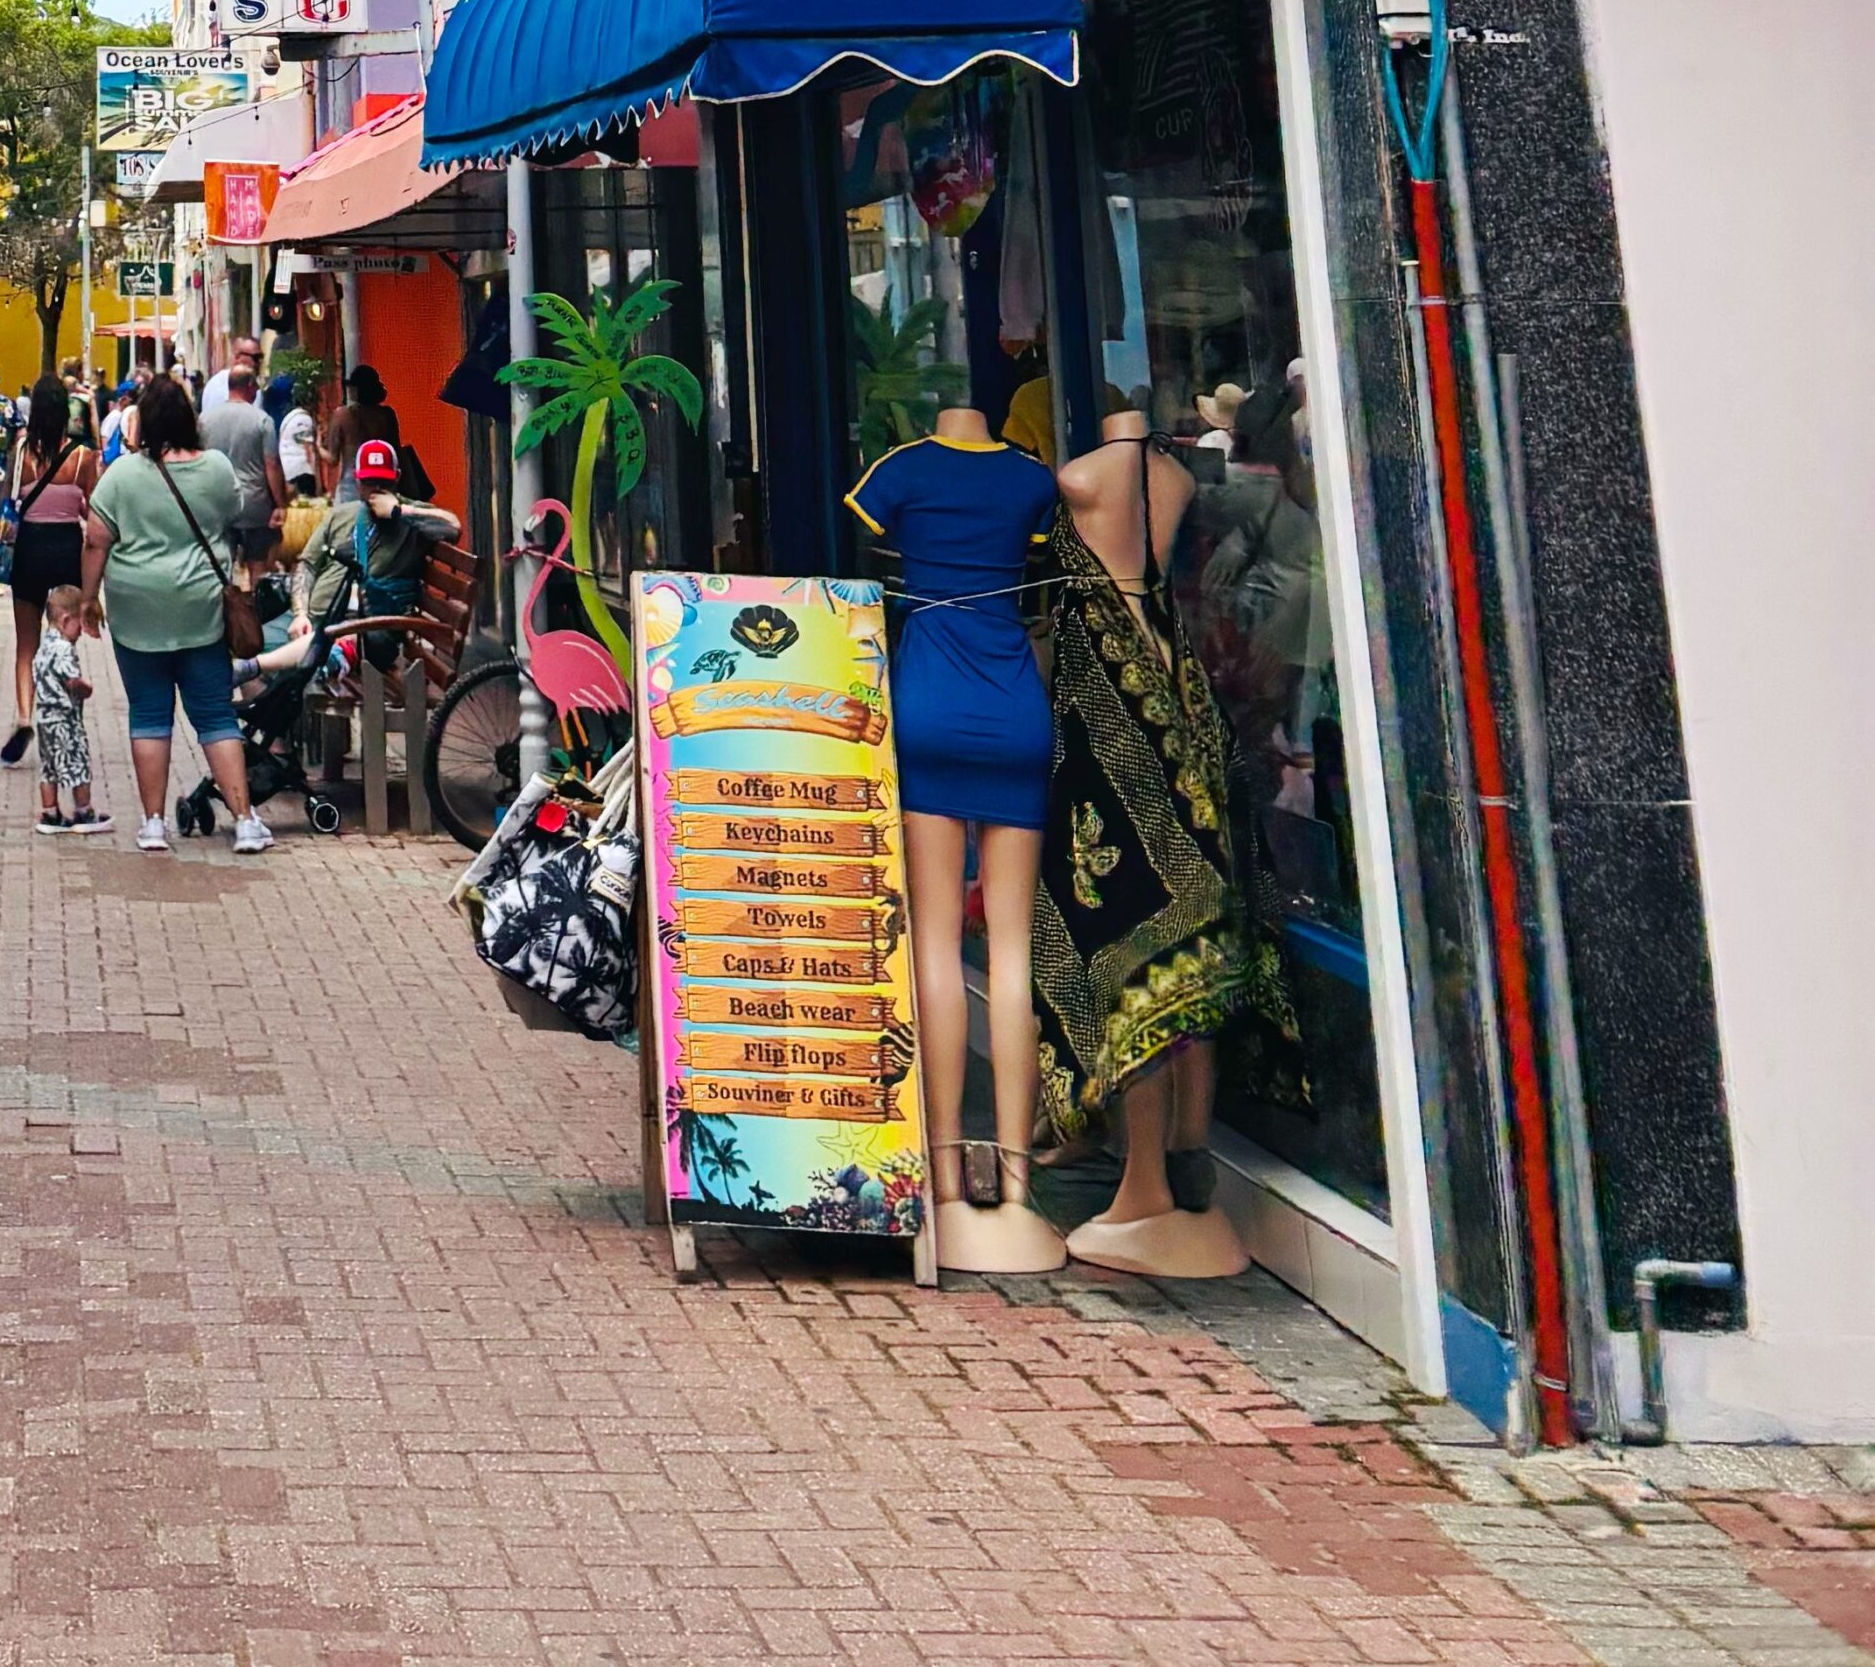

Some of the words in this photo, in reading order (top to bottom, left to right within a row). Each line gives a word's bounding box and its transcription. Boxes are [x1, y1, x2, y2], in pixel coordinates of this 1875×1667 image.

[106, 52, 169, 68] Ocean
[175, 53, 245, 69] Lovers
[134, 89, 214, 111] BIG
[717, 778, 786, 799] Coffee
[790, 781, 838, 805] Mug
[725, 822, 835, 845] Keychains
[736, 866, 828, 890] Magnets
[747, 907, 827, 929] Towels
[723, 954, 773, 977] Caps
[779, 957, 795, 974] &
[802, 957, 852, 977] Hats
[728, 997, 794, 1019] Beach
[800, 1004, 856, 1021] wear
[743, 1042, 785, 1066] Flip
[790, 1043, 847, 1070] flops
[707, 1082, 795, 1104] Souviner
[801, 1088, 814, 1104] &
[819, 1089, 866, 1108] Gifts
